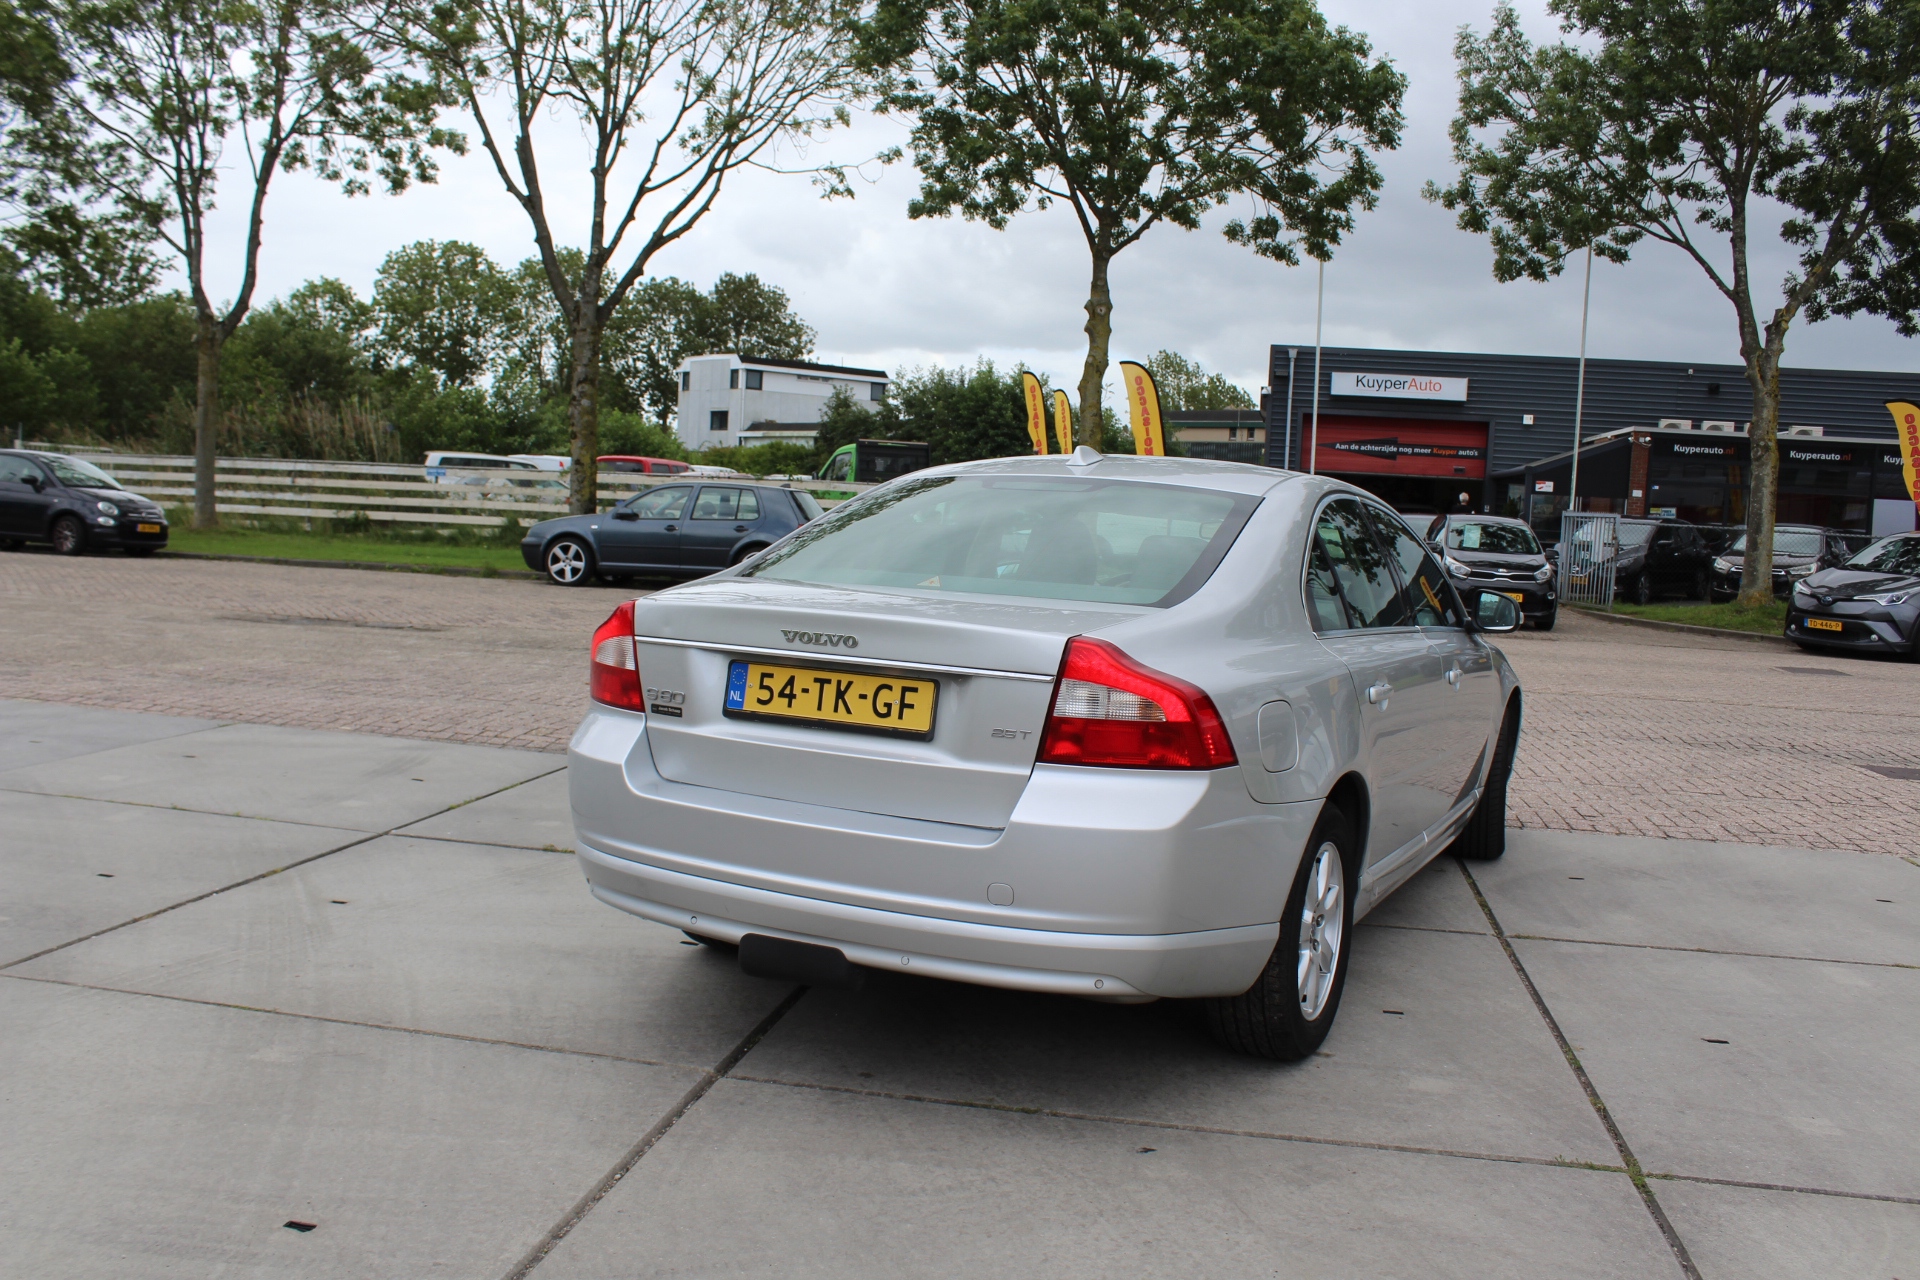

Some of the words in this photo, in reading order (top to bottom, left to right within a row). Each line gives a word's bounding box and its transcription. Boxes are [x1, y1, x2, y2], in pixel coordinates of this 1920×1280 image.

[1355, 375, 1442, 392] KuyperAuto
[1350, 443, 1359, 451] de
[1360, 444, 1398, 453] achterzijde
[1433, 447, 1457, 456] Kuyper
[1673, 444, 1735, 455] Kuyperauto.nl
[1789, 450, 1851, 461] Kuyperauto.nl
[780, 629, 859, 649] VOLVO
[729, 690, 743, 702] NL
[756, 671, 919, 721] 54-TK-GF
